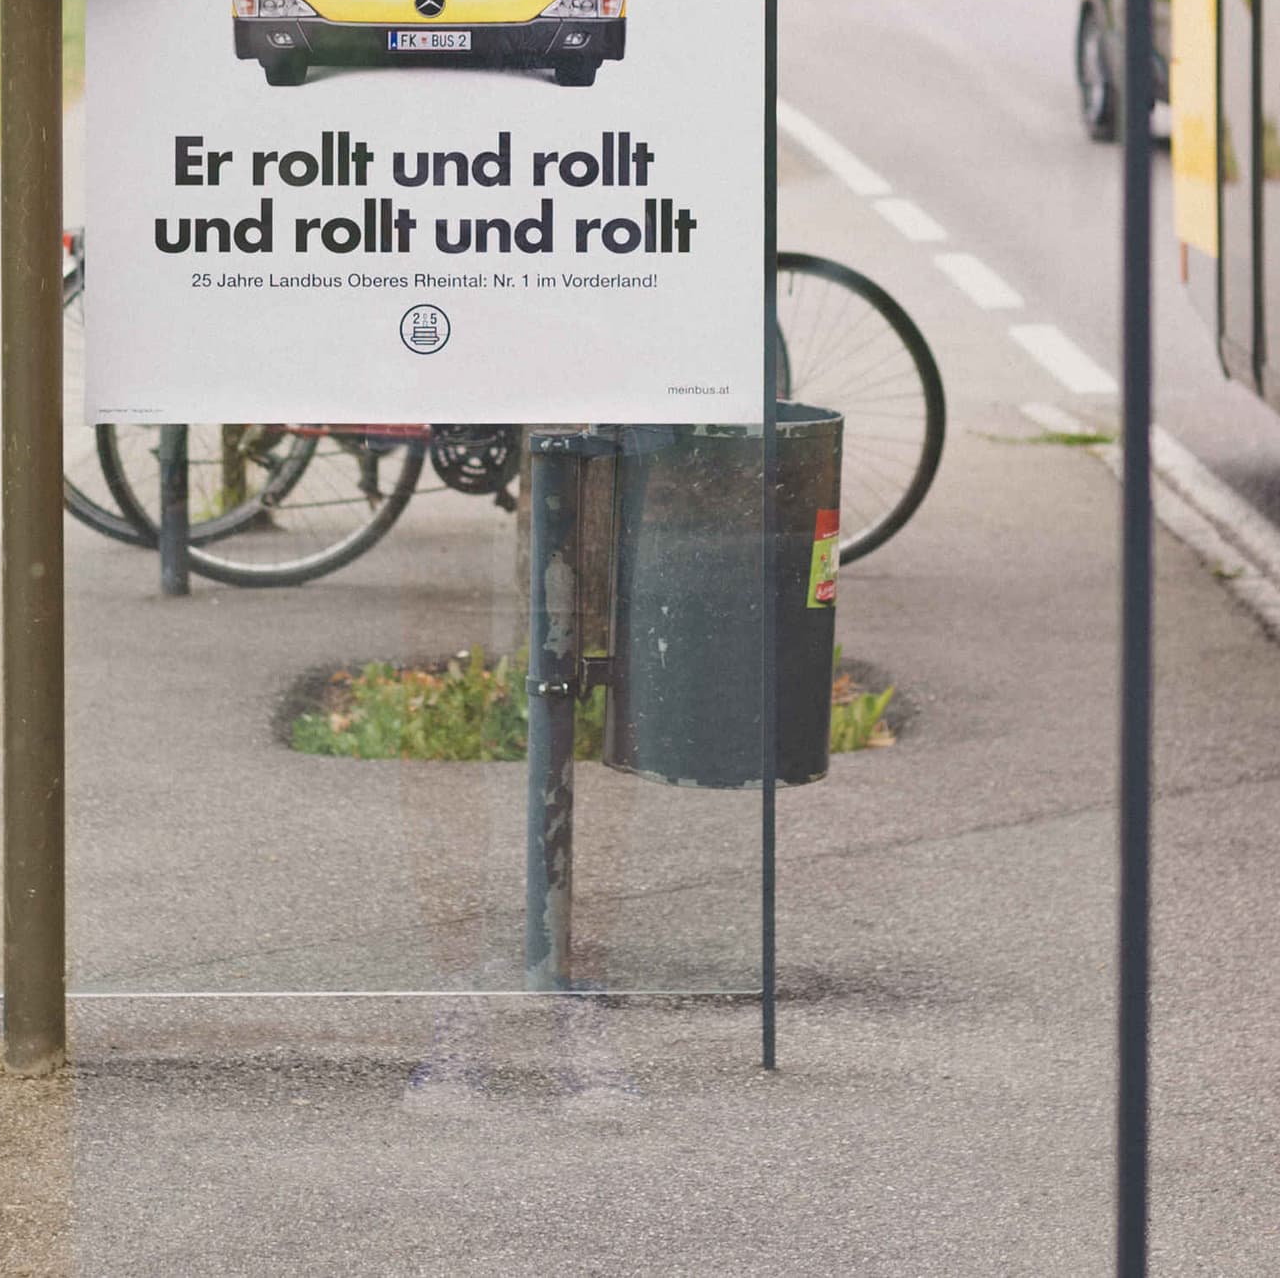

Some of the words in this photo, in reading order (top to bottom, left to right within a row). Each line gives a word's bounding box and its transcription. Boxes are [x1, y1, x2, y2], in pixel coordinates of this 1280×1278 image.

[400, 34, 417, 48] FK
[431, 34, 455, 48] BUS
[458, 34, 467, 48] 2
[175, 135, 233, 186] Er
[252, 131, 375, 187] rollt
[393, 131, 511, 188] und
[533, 131, 655, 188] rollt
[154, 198, 273, 254] und
[295, 198, 417, 254] rollt
[435, 198, 554, 255] und
[575, 198, 697, 255] rollt
[191, 273, 212, 288] 25
[217, 273, 264, 288] Jahre
[269, 273, 343, 288] Landbus
[347, 273, 409, 288] Oberes
[414, 273, 487, 289] Rheintal:
[493, 274, 515, 289] Nr.
[520, 274, 530, 289] 1
[536, 274, 556, 289] im
[562, 273, 658, 289] Vorderland!
[667, 385, 730, 395] meinbus.at
